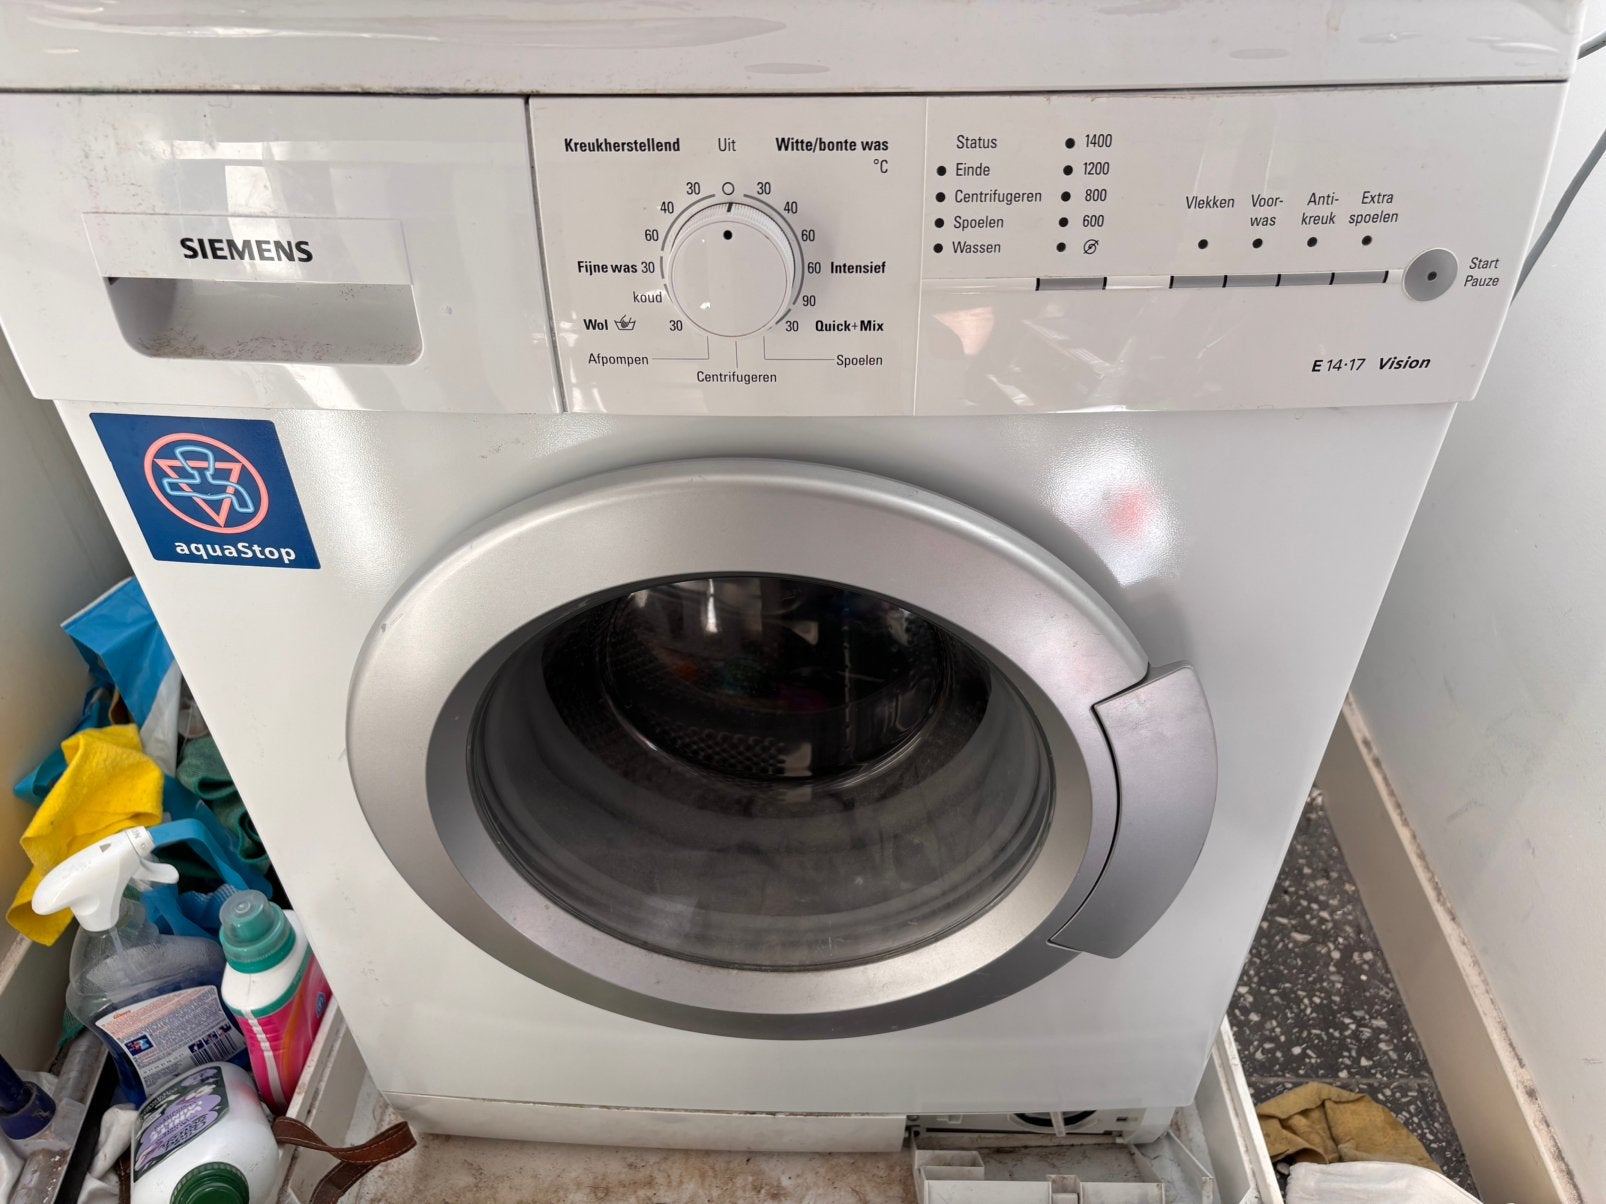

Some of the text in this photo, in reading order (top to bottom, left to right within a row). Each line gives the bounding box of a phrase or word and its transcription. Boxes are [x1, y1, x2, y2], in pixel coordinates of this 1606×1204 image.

[564, 137, 681, 153] Kreukherstellend
[717, 137, 737, 152] Uit
[775, 137, 889, 153] Witte/bonte was
[956, 134, 998, 150] Status
[1085, 133, 1113, 148] 1400
[873, 158, 889, 174] °C
[955, 162, 991, 177] Einde
[1083, 161, 1110, 176] 1200
[685, 181, 701, 196] 30
[756, 181, 772, 196] 30
[1084, 188, 1108, 202] 800
[954, 188, 1042, 206] Centrifugeren
[1185, 195, 1235, 210] Vlekken
[1251, 193, 1284, 208] Voor-
[1306, 191, 1340, 206] Anti-
[1361, 190, 1394, 205] Extra
[660, 200, 675, 215] 40
[783, 200, 798, 215] 40
[953, 215, 1004, 232] Spoelen
[1082, 214, 1105, 228] 600
[1249, 216, 1277, 228] was
[1301, 211, 1337, 226] kreuk
[1348, 209, 1399, 227] spoelen
[644, 228, 659, 242] 60
[801, 228, 816, 242] 60
[180, 238, 313, 262] SIEMENS
[951, 240, 1001, 254] Wassen
[577, 260, 656, 276] Fijne was 30
[807, 260, 887, 275] 60 Intensief
[1468, 256, 1500, 270] Start
[1463, 274, 1500, 287] Pauze
[632, 290, 663, 304] koud
[802, 294, 816, 307] 90
[583, 318, 610, 331] Wol
[669, 319, 683, 332] 30
[785, 320, 799, 333] 30
[588, 352, 649, 368] Afpompen
[836, 354, 883, 369] Spoelen
[1311, 359, 1324, 373] E
[1377, 355, 1431, 370] Vision
[696, 370, 777, 385] Centrifugeren
[174, 542, 297, 564] aquaStop
